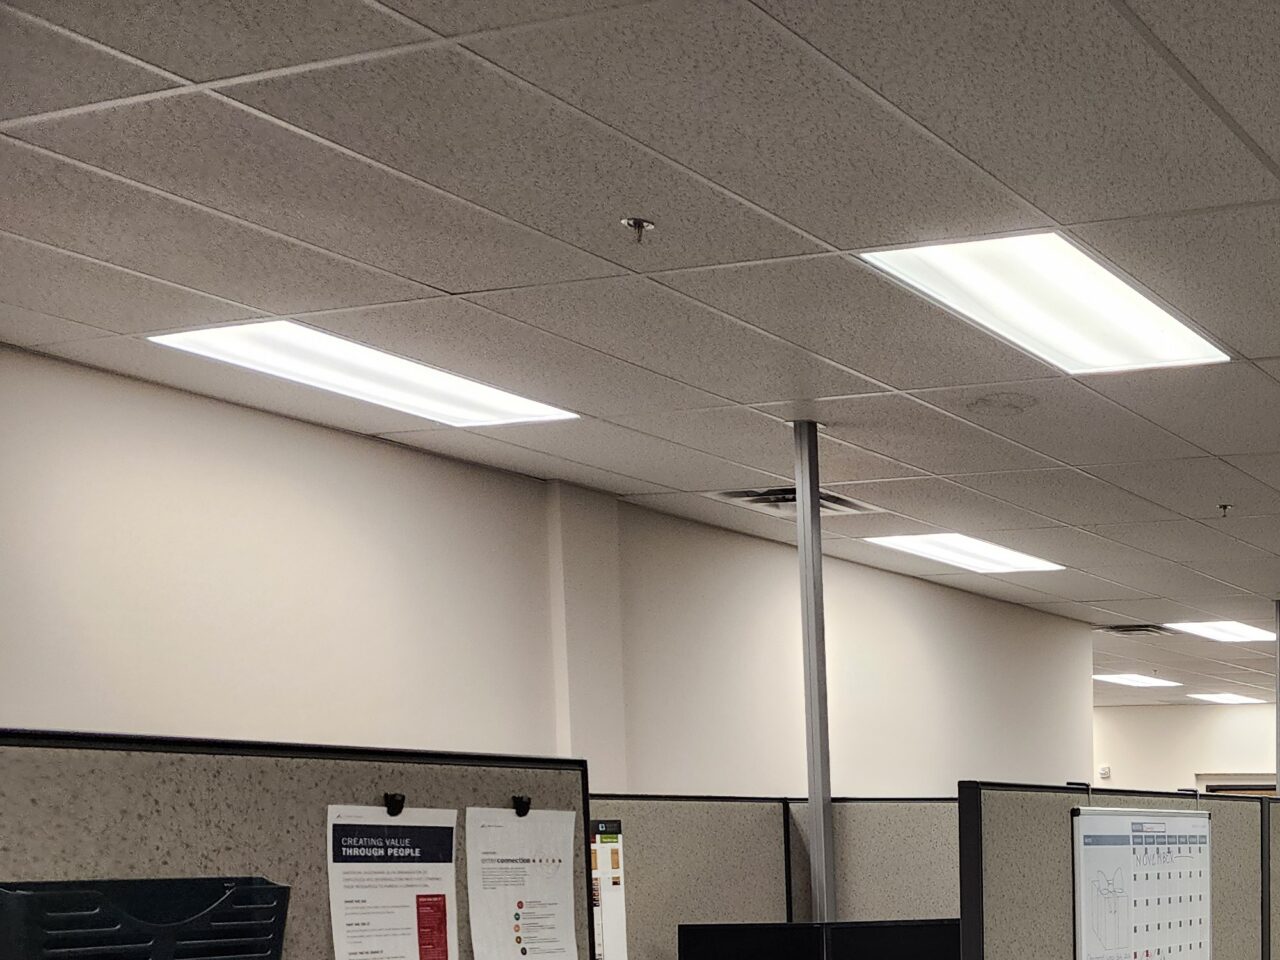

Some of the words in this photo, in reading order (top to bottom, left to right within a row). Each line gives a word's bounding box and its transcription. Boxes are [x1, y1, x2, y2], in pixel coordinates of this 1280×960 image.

[341, 837, 383, 846] CREATING
[385, 838, 411, 847] VALUE
[341, 847, 385, 856] THROUGH
[387, 847, 421, 857] PEOPLE
